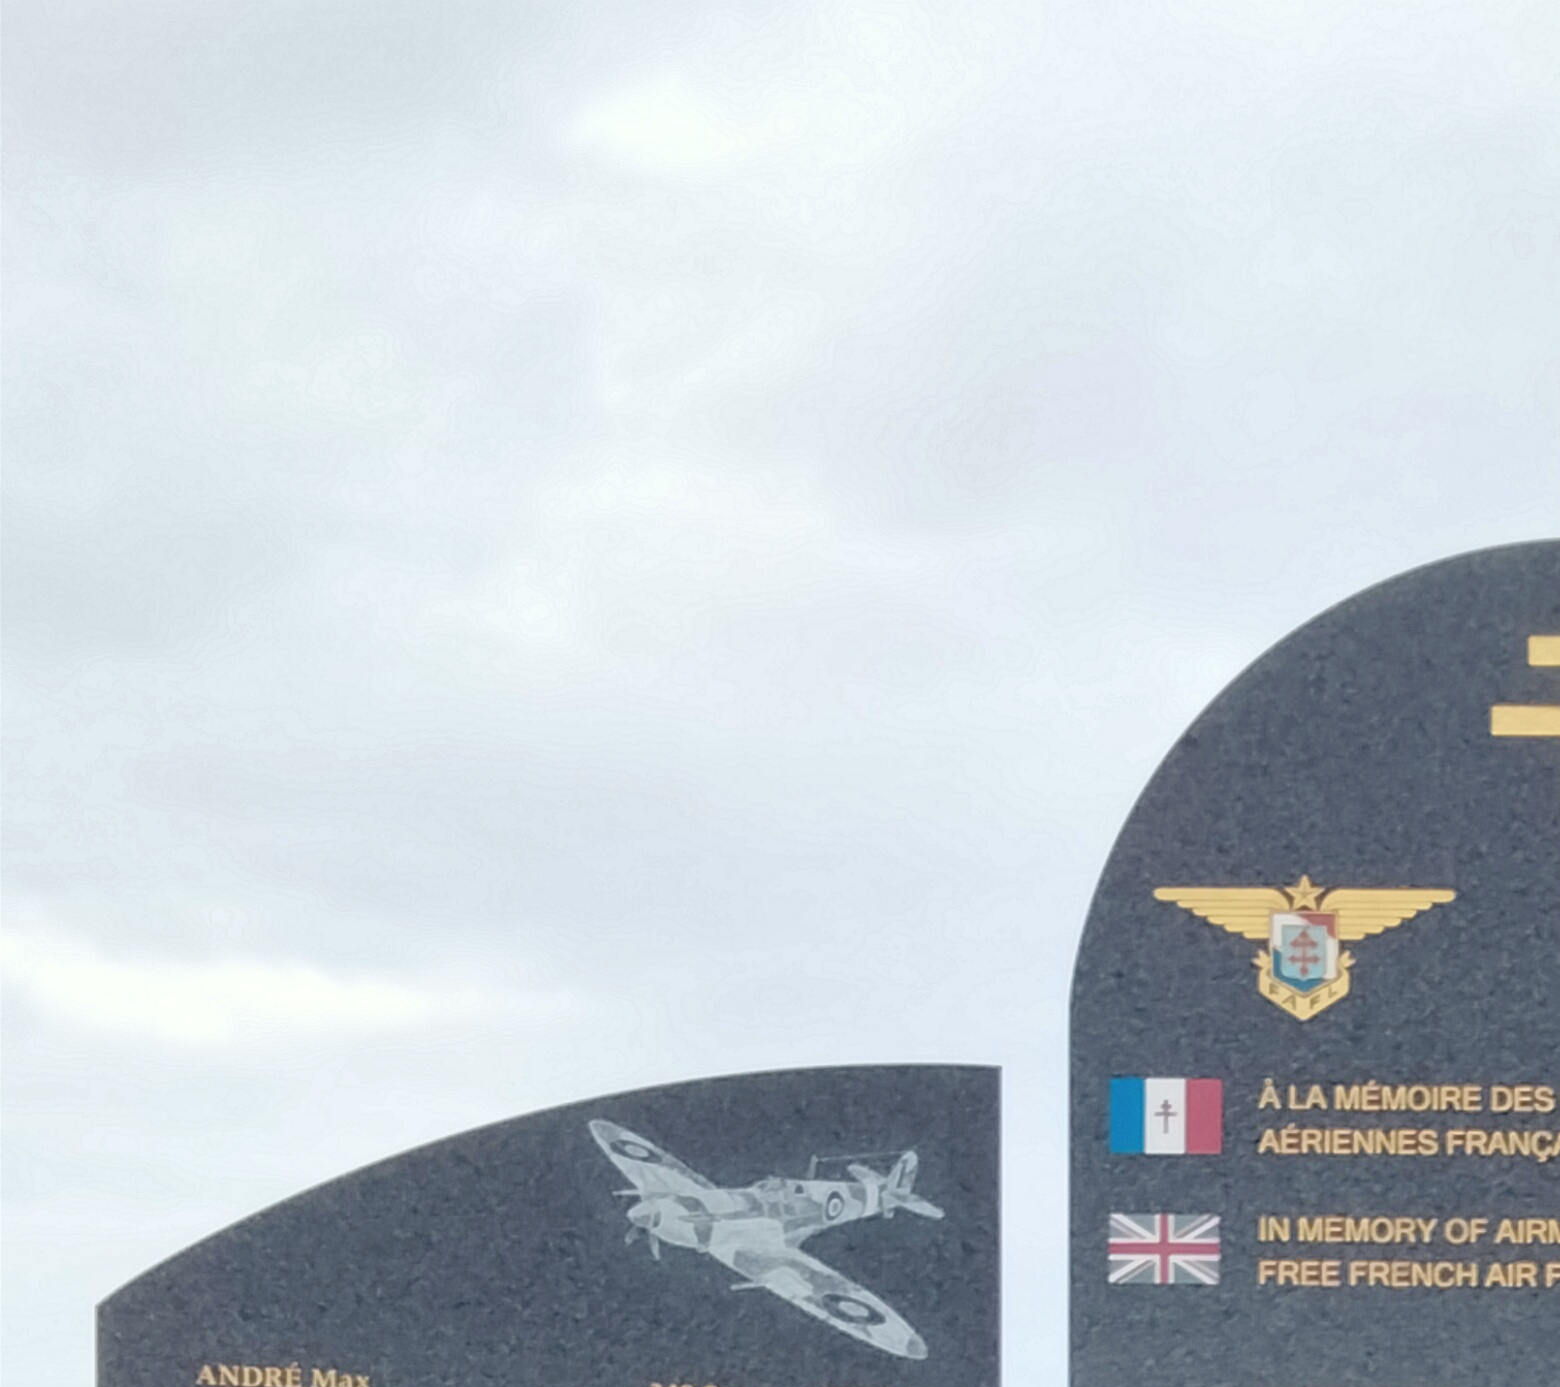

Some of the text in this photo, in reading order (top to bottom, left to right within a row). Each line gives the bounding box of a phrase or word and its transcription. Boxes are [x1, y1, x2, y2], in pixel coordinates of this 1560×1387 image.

[1289, 1085, 1327, 1110] LA
[1334, 1081, 1481, 1111] MÉMOIRE
[1491, 1086, 1555, 1112] DES
[1258, 1124, 1439, 1155] AÉRIENNES
[1259, 1217, 1290, 1241] IN
[1297, 1216, 1437, 1242] MEMORY
[1445, 1218, 1488, 1244] OF
[1259, 1260, 1340, 1286] FREE
[1349, 1261, 1478, 1287] FRENCH
[1485, 1262, 1537, 1287] AIR
